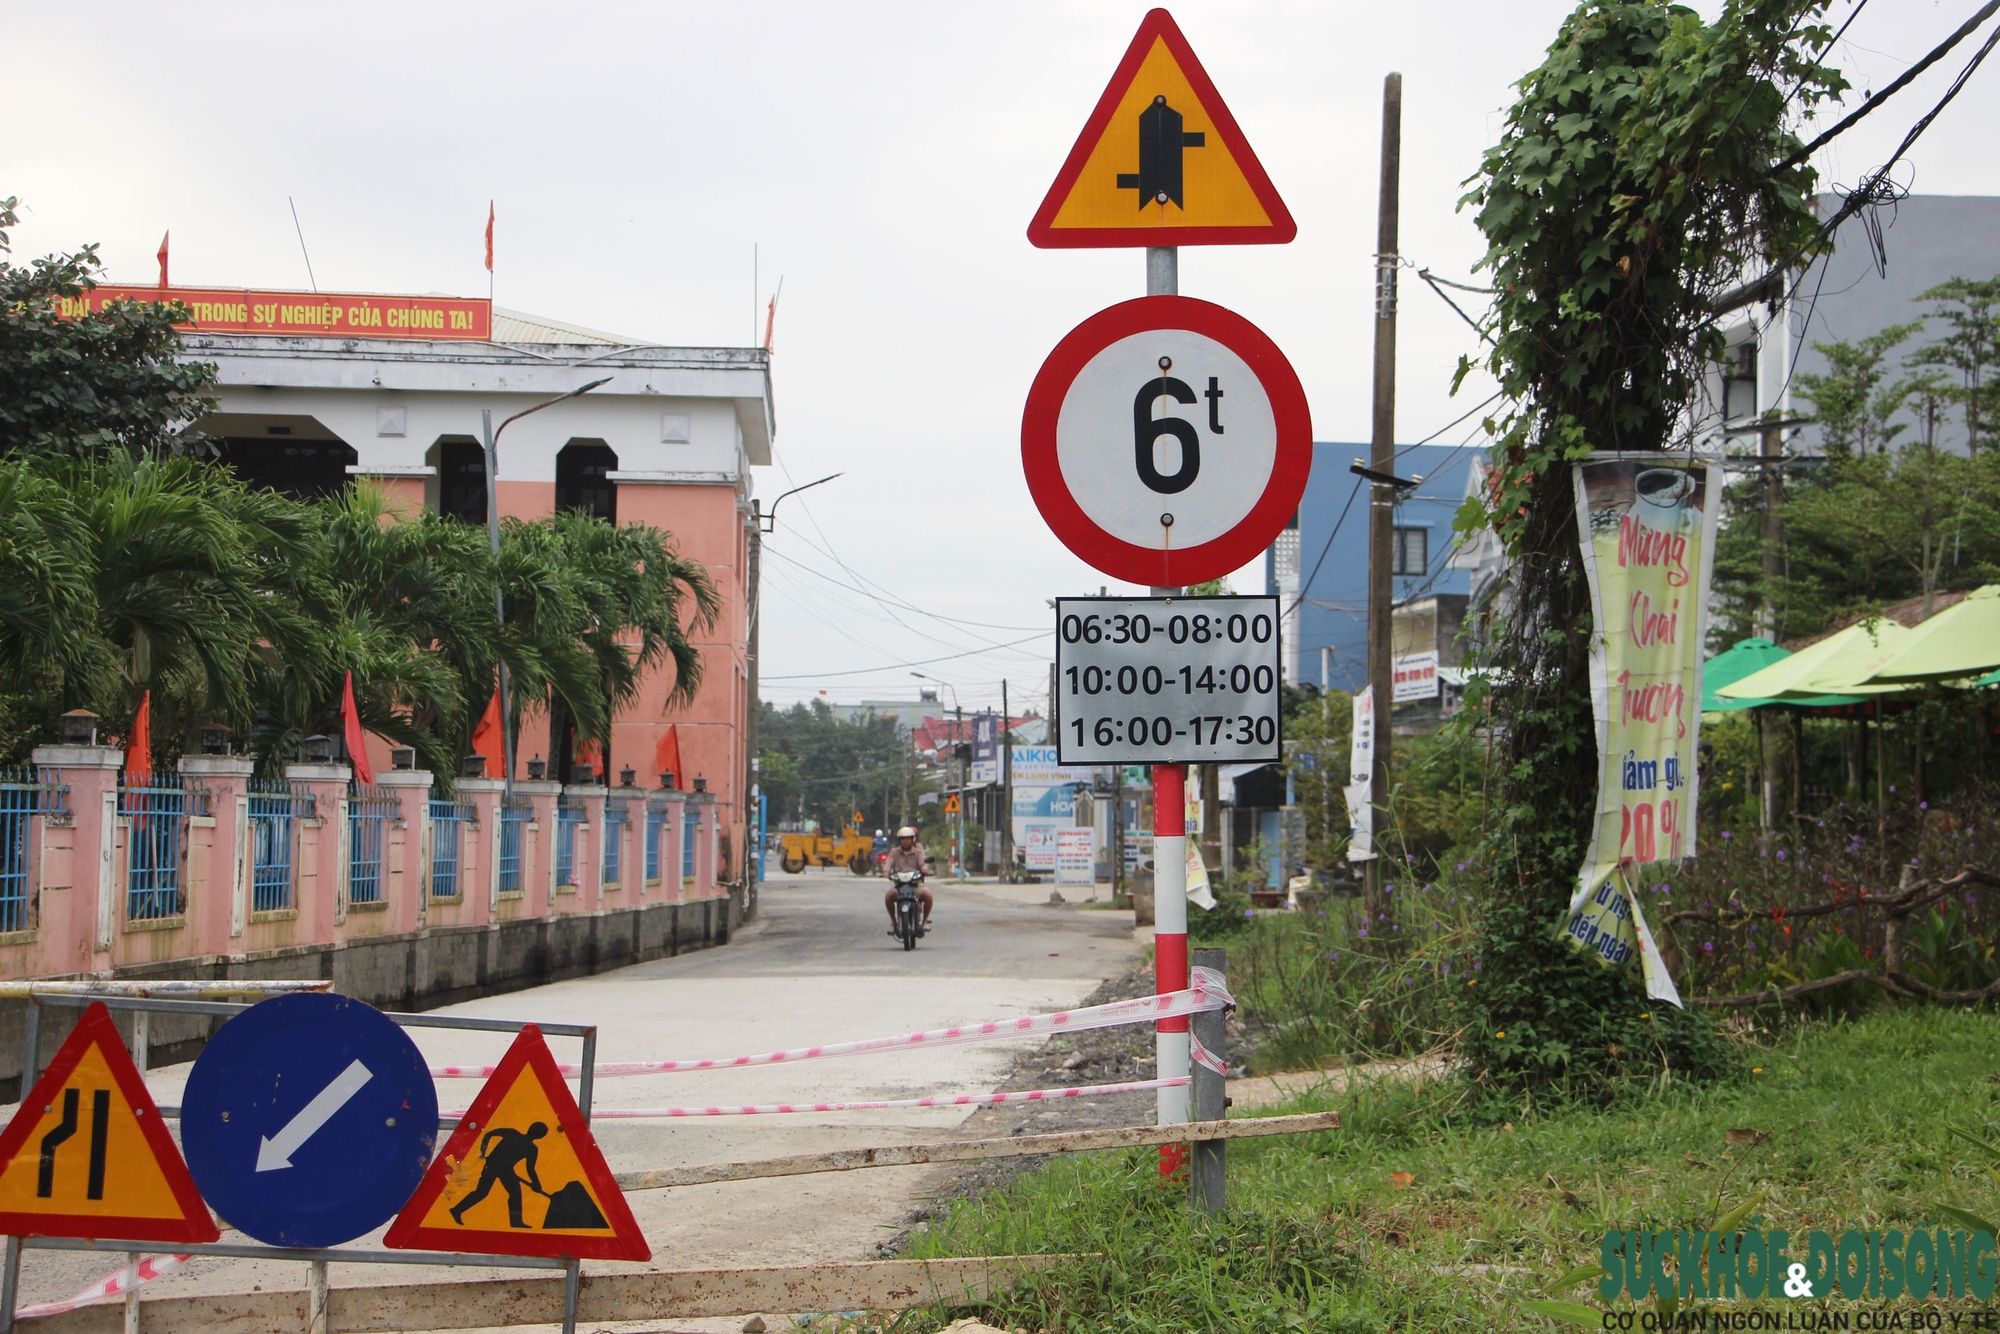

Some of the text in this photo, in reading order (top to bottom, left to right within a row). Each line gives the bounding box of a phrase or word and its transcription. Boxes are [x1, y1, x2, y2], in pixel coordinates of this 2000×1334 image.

[192, 302, 248, 323] TRONG
[253, 302, 277, 328] SỰ
[281, 303, 343, 329] NGHIỆP
[349, 301, 382, 327] CỦA
[387, 305, 444, 329] CHÚNG
[449, 310, 474, 330] TA!
[1061, 613, 1273, 645] 06:30-08:00
[1629, 590, 1679, 649] Khai
[1065, 664, 1274, 695] 10:00-14:00
[1070, 715, 1276, 747] 16:00-17:30
[1011, 749, 1057, 762] AIKIO
[1622, 749, 1657, 790] iảm
